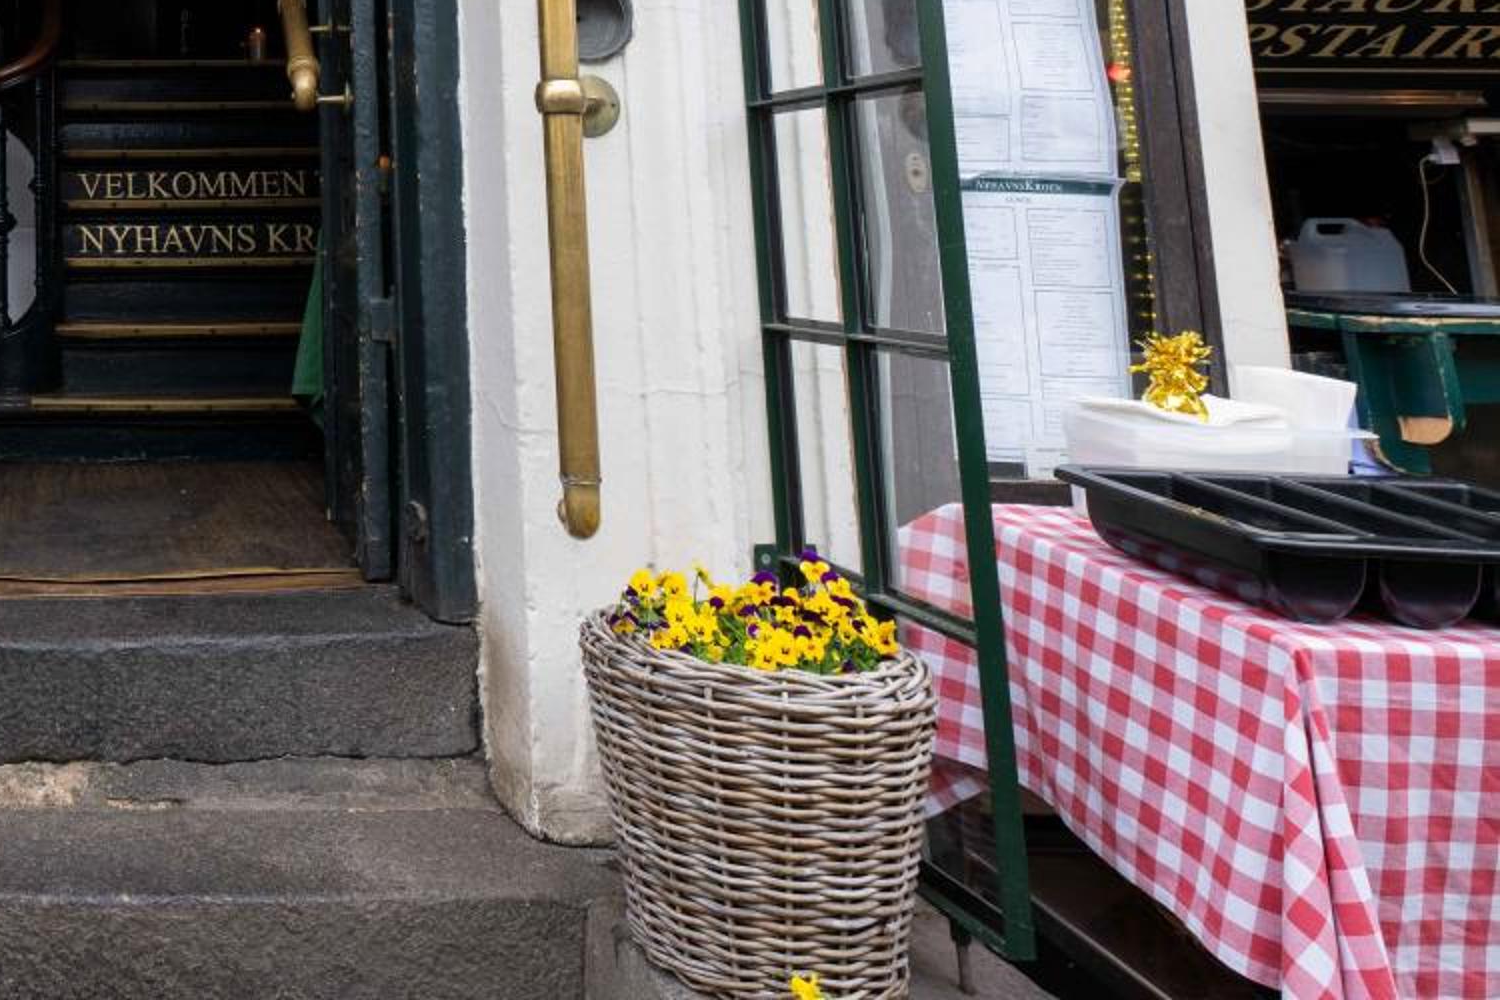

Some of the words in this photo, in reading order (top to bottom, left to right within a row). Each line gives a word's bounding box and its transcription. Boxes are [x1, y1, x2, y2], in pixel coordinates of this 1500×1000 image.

[1250, 23, 1500, 59] PSTAIR
[77, 170, 307, 199] VELKOMMEN
[78, 223, 257, 253] NYHAVNS
